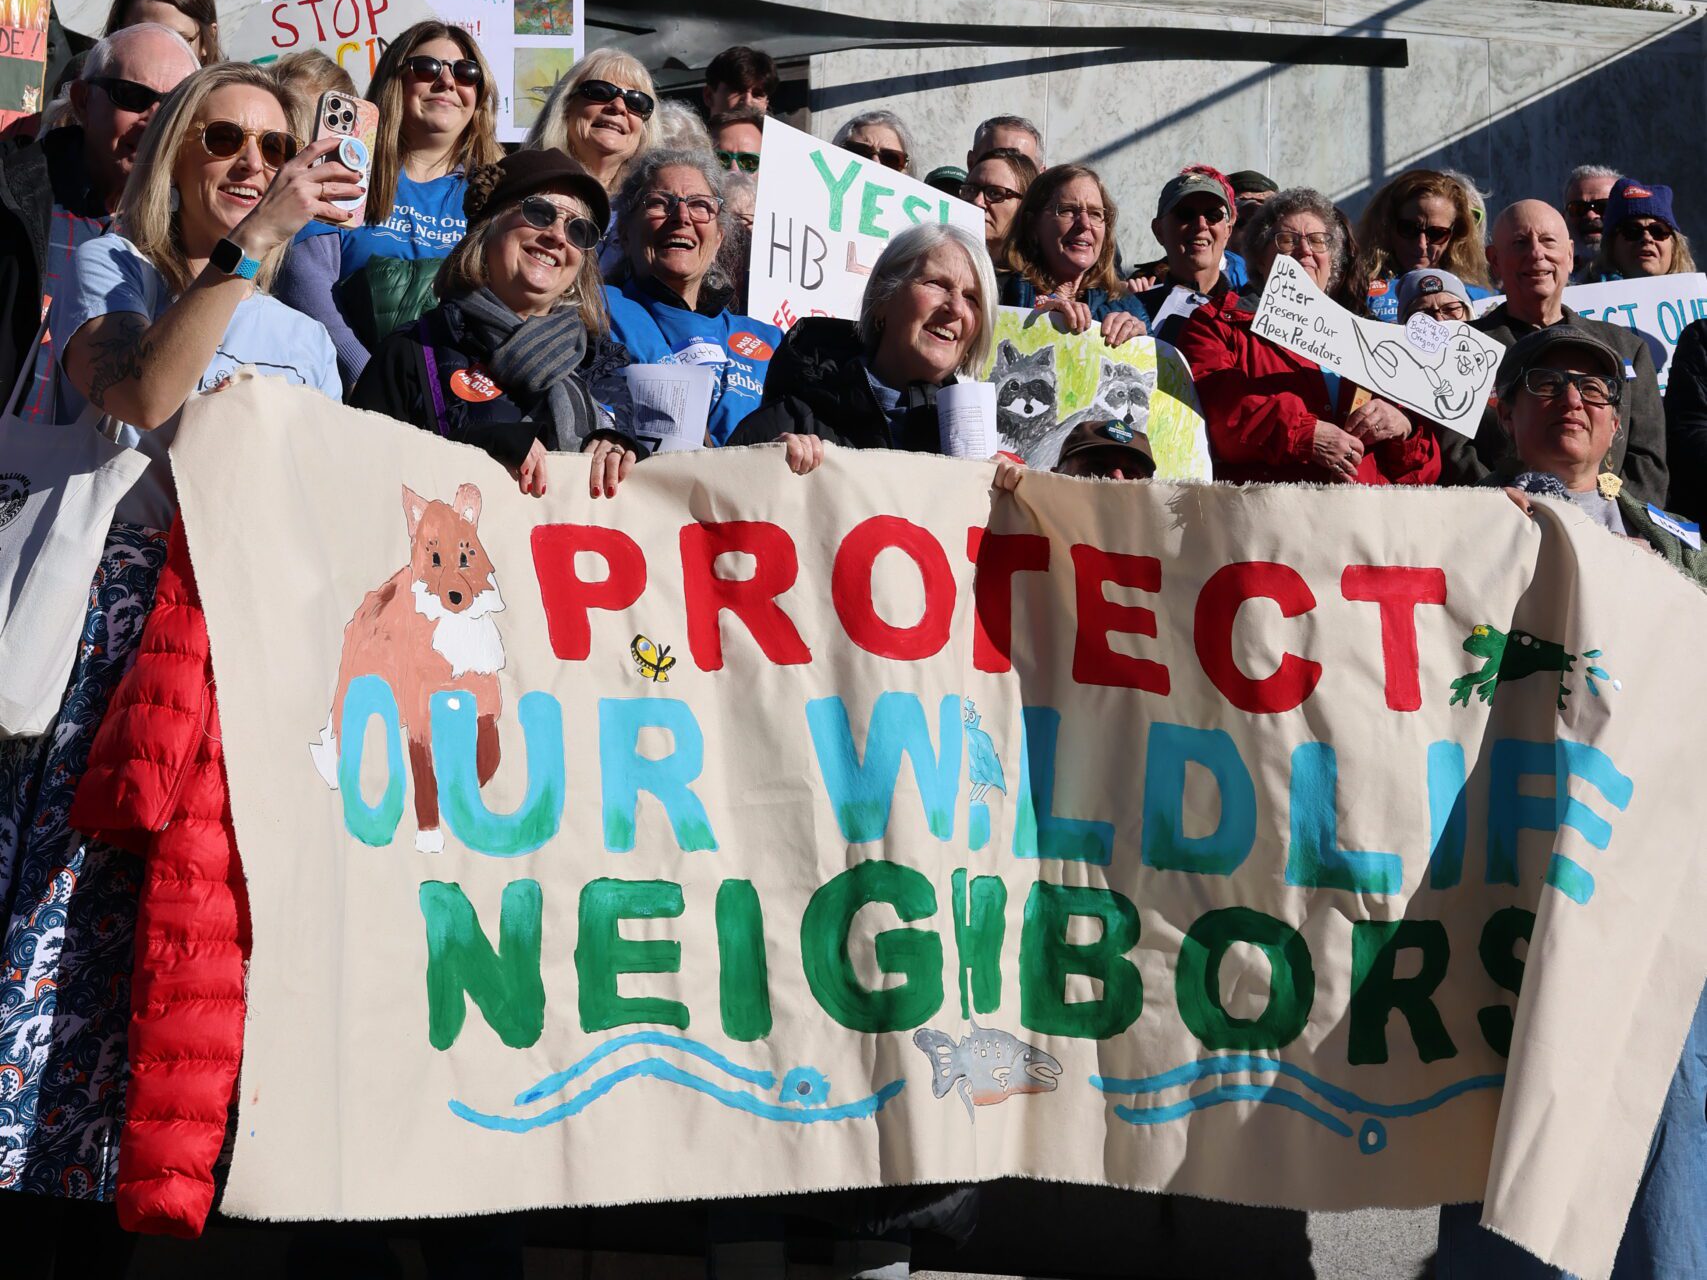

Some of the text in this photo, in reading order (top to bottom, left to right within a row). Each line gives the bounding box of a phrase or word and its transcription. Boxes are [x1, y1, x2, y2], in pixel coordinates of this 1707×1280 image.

[393, 204, 468, 228] rotect Ou
[415, 222, 467, 244] Neigh
[769, 212, 828, 291] HB
[1277, 261, 1297, 279] We
[1269, 275, 1315, 306] Otter
[1263, 293, 1339, 338] Preserve Our
[1410, 320, 1427, 336] Back
[1255, 313, 1343, 365] Apex Predators
[1410, 331, 1437, 349] Oregon
[676, 345, 718, 365] Ruth
[530, 514, 1447, 714] PROTECT
[338, 674, 720, 858] OUR
[418, 858, 1538, 1065] NEIGHBORS
